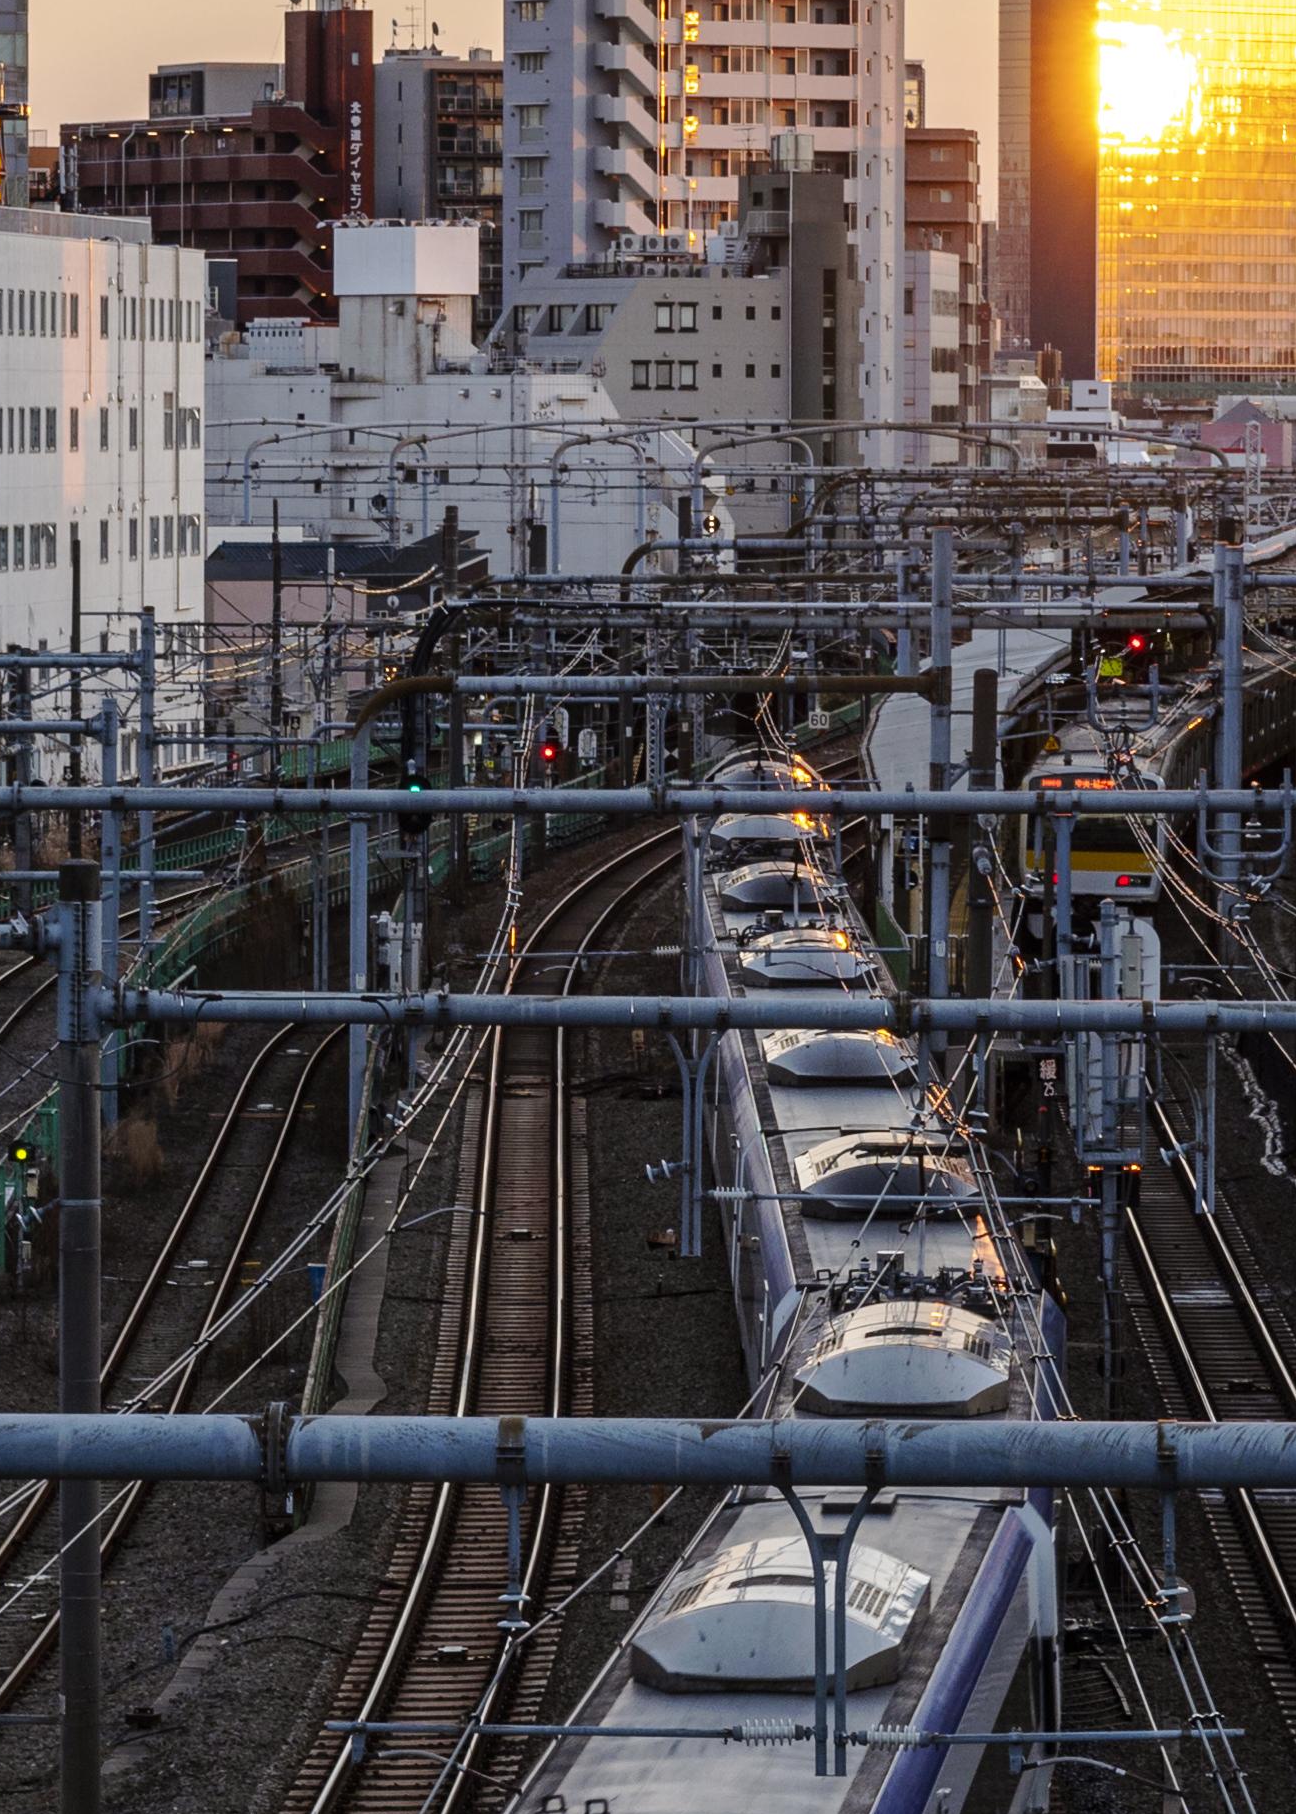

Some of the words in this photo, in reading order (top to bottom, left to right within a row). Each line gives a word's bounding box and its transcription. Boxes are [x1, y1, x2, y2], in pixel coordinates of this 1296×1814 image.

[350, 101, 363, 214] 北参道ダイヤモン
[811, 713, 828, 726] 60
